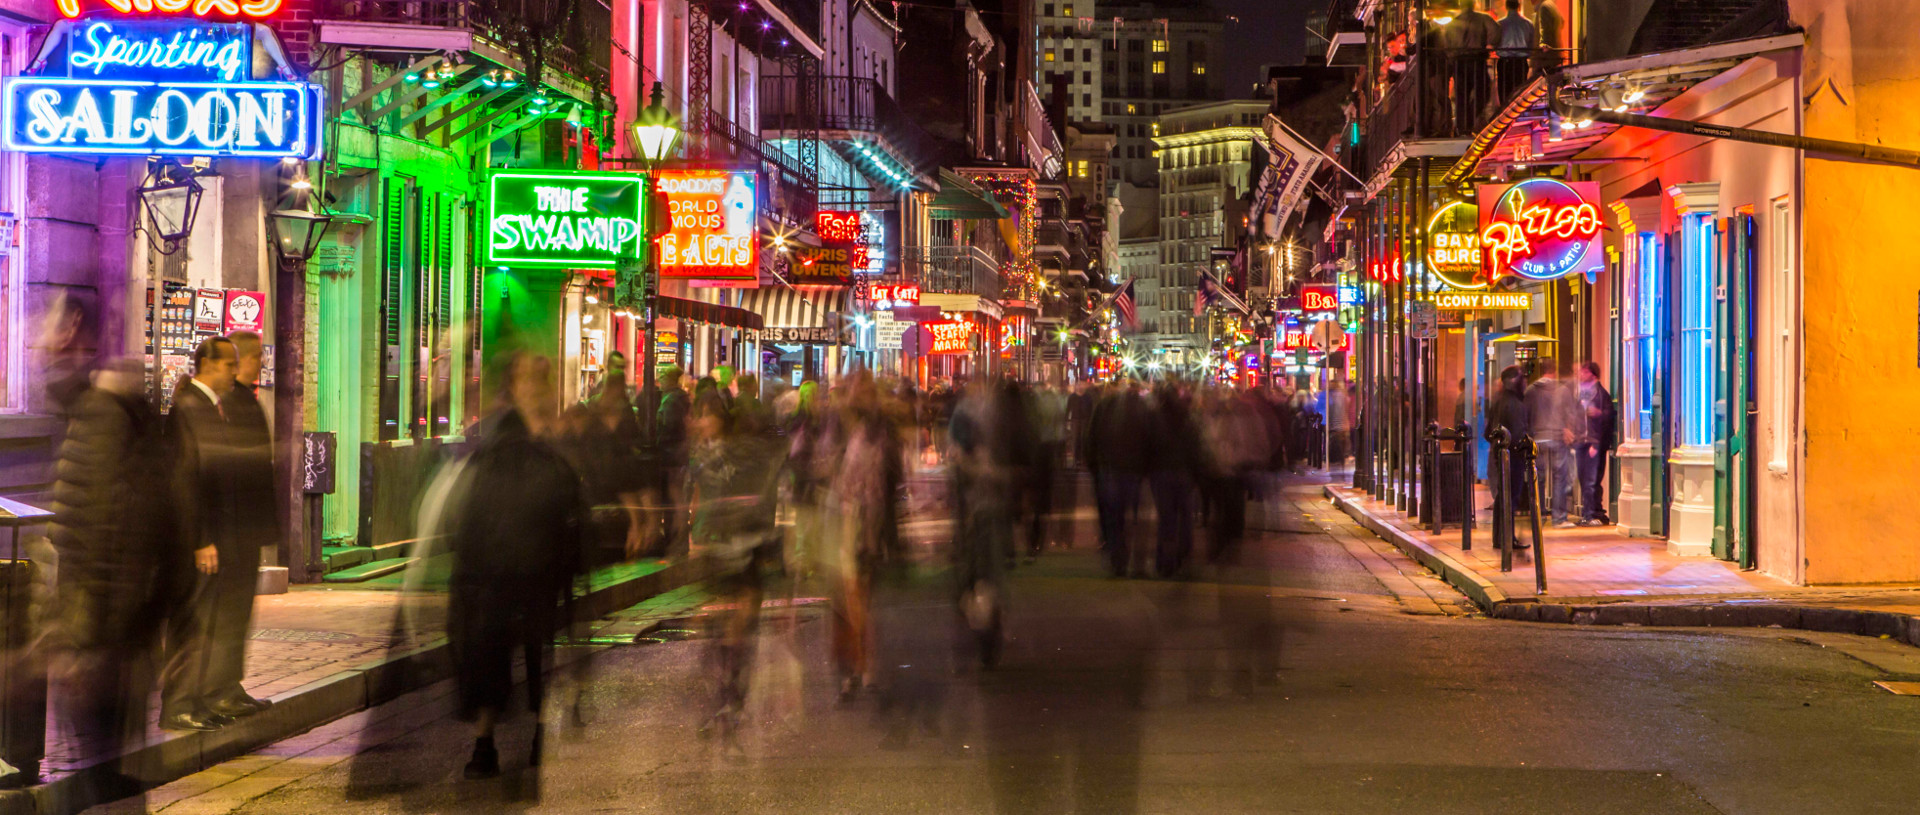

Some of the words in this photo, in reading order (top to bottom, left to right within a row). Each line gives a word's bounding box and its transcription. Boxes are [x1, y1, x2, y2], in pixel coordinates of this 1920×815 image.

[70, 22, 243, 80] Sporting
[27, 87, 286, 147] SALOON
[535, 186, 589, 212] THE
[493, 214, 637, 254] SWAMP
[1435, 233, 1480, 248] BAY
[681, 234, 751, 266] ACTS
[1522, 261, 1544, 274] CLUB
[1549, 262, 1557, 272] &
[1559, 241, 1582, 269] PATIO
[791, 262, 851, 277] OWENS
[1305, 292, 1338, 309] Ba
[1483, 294, 1528, 307] DINING
[242, 310, 249, 321] 1
